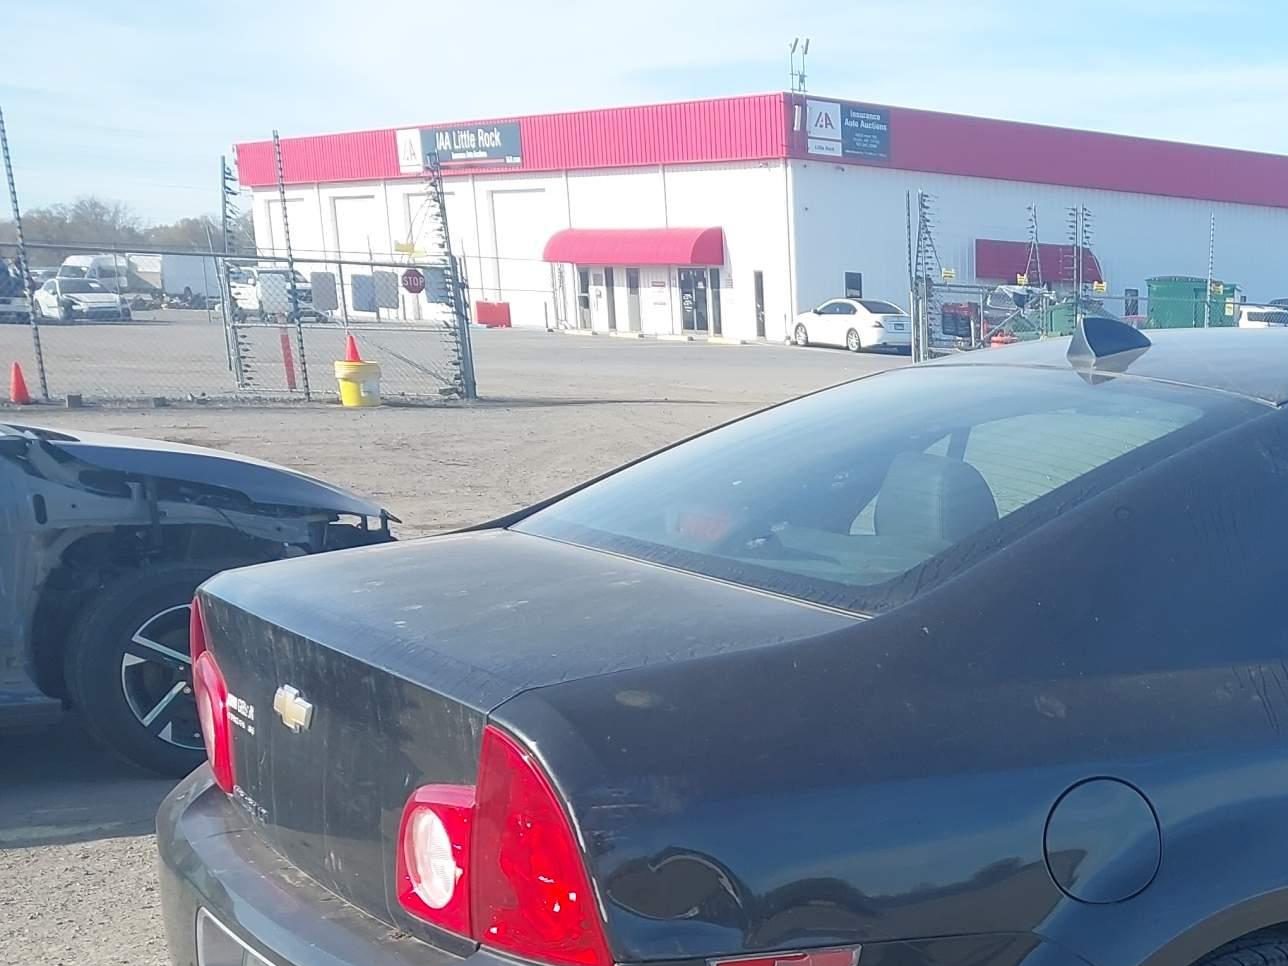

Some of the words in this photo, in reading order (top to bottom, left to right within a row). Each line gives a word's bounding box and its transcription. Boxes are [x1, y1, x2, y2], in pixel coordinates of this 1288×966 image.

[850, 109, 881, 121] Insurance
[844, 118, 859, 128] Auto
[860, 120, 887, 131] Auctions
[435, 131, 452, 151] IAA
[452, 129, 477, 150] Little
[477, 127, 502, 148] Rock
[403, 276, 424, 287] STOP
